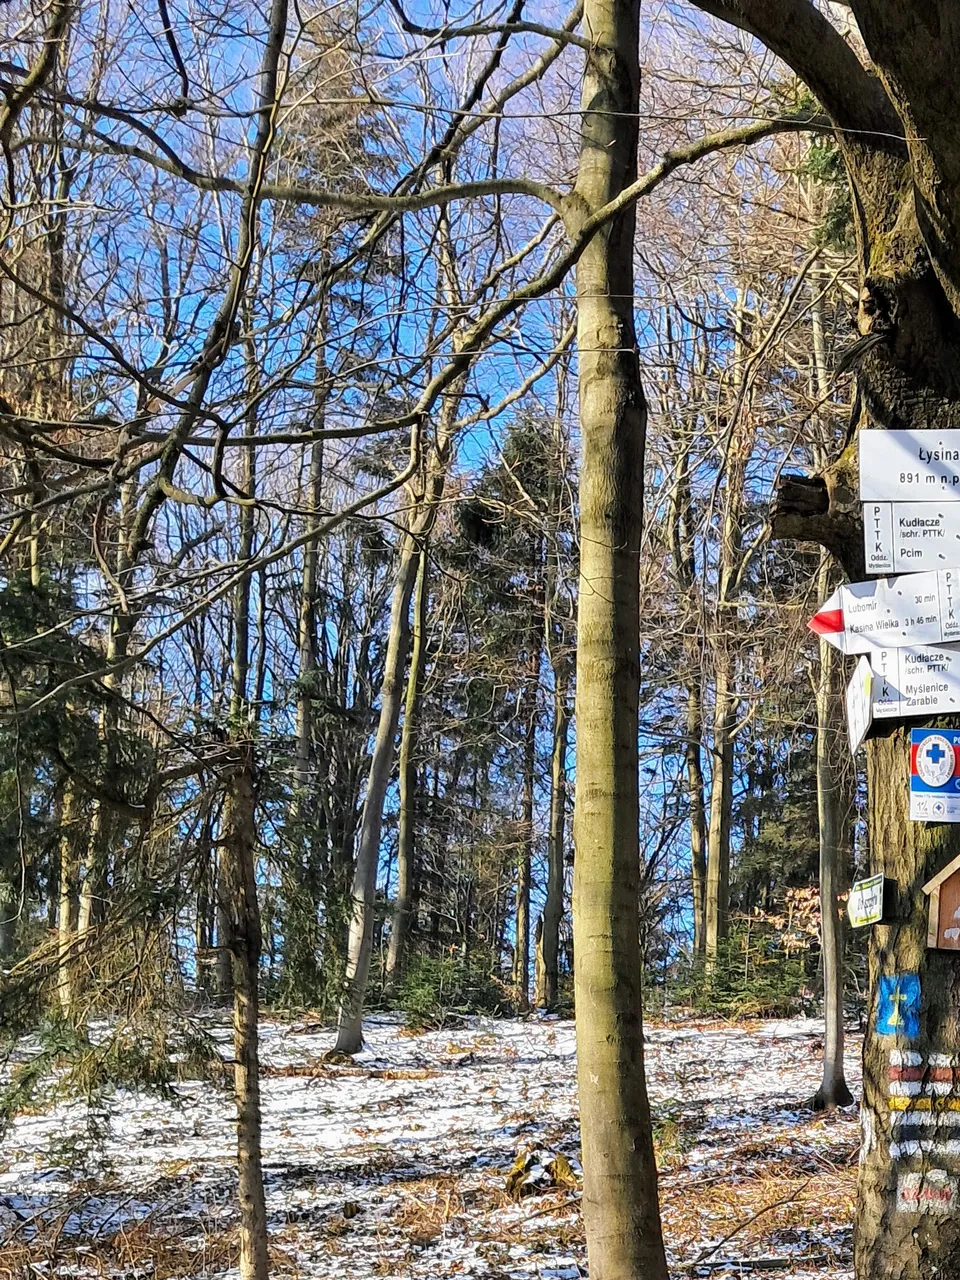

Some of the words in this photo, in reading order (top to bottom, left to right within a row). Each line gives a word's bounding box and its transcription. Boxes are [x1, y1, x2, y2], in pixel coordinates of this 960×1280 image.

[918, 447, 960, 464] Łysina
[899, 472, 920, 484] 891
[925, 474, 936, 484] m
[899, 517, 940, 527] Kudłacze
[922, 529, 946, 538] PTTK/
[900, 548, 923, 558] Pcim
[848, 602, 878, 614] Lubomir
[914, 595, 922, 604] 30
[923, 594, 936, 603] min
[849, 623, 874, 634] Kasina
[875, 619, 900, 630] Wielka
[904, 618, 910, 627] 3
[910, 617, 915, 626] h
[925, 615, 937, 624] min
[904, 653, 944, 664] Kudłacze
[926, 663, 949, 673] PTTK/
[905, 682, 949, 696] Myślenice
[906, 695, 938, 707] Zarabie
